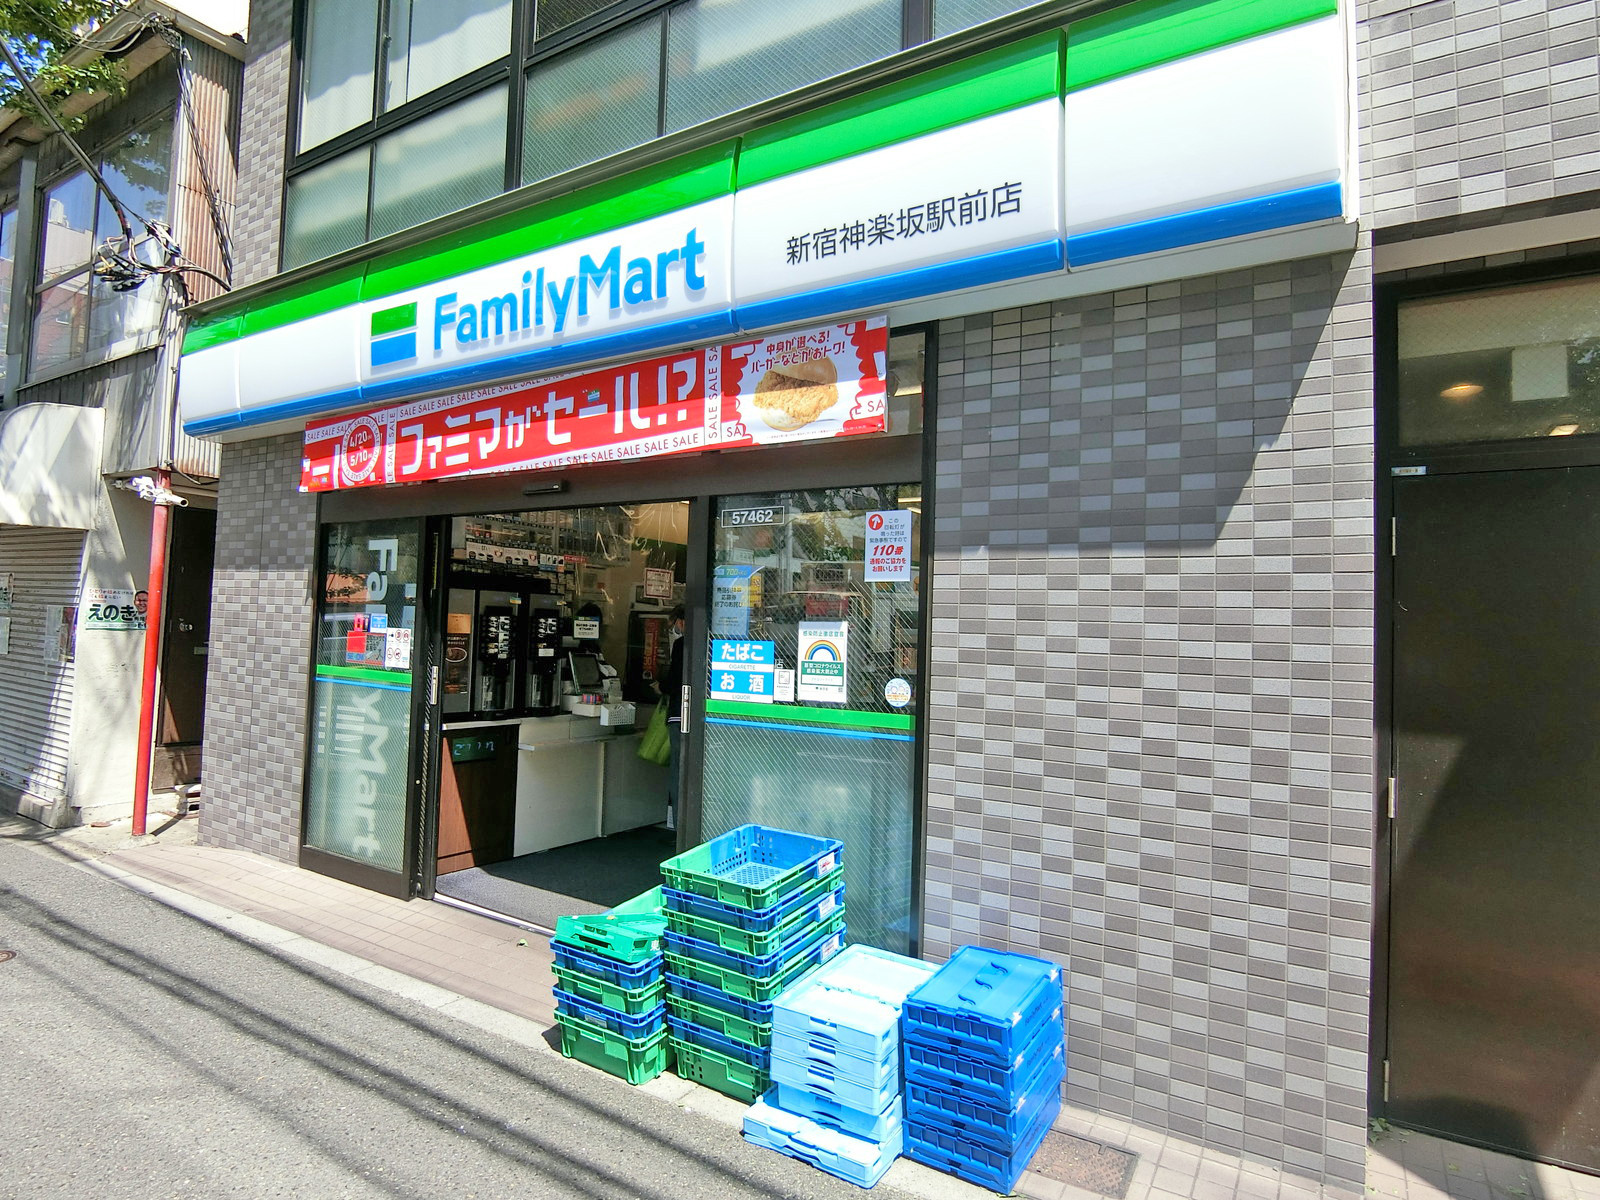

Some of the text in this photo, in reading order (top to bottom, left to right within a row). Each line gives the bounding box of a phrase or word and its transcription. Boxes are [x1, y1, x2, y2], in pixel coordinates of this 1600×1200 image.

[787, 181, 1023, 265] 新宿神楽坂駅前店
[434, 226, 706, 350] FamilyMart
[708, 366, 718, 401] SALE
[400, 406, 417, 418] SALE
[418, 402, 435, 413] SALE
[437, 395, 455, 408] SALE
[456, 391, 475, 403] SALE
[708, 405, 718, 439] SALE
[307, 431, 320, 442] SALE
[321, 428, 335, 438] SALE
[349, 430, 368, 448] 4/20
[591, 449, 614, 461] SALE
[617, 444, 640, 458] SALE
[644, 438, 669, 453] SALE
[672, 433, 699, 448] SALE
[350, 449, 368, 467] 5/10
[732, 509, 773, 525] 57462
[873, 544, 904, 556] 110番
[721, 642, 764, 661] たばこ
[728, 663, 756, 671] CIGARETTE
